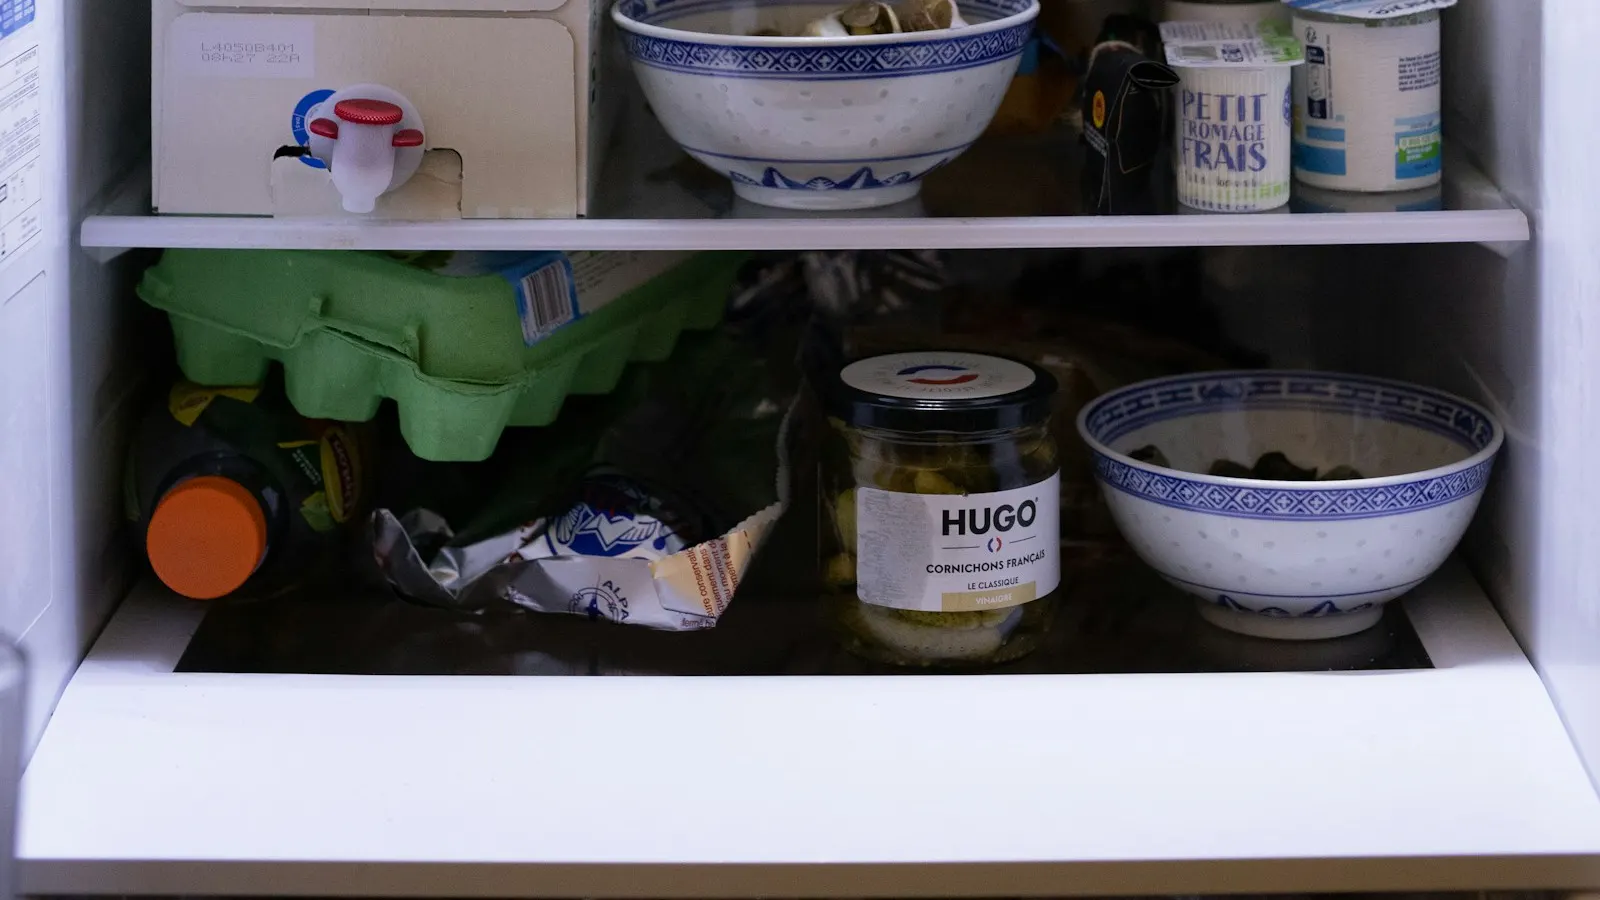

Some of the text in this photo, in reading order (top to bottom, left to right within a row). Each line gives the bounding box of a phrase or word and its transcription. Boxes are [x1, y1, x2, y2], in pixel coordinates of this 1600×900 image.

[1183, 89, 1268, 121] PETIT
[1182, 118, 1265, 141] FROMAGE
[1183, 137, 1267, 172] FRAIS
[942, 499, 1036, 536] HUGO
[712, 549, 728, 588] moment
[926, 549, 1046, 574] CORNICHONS FRANÇAIS
[967, 577, 1019, 590] LE CLASSIQUE
[975, 594, 1013, 605] VINAIGRE
